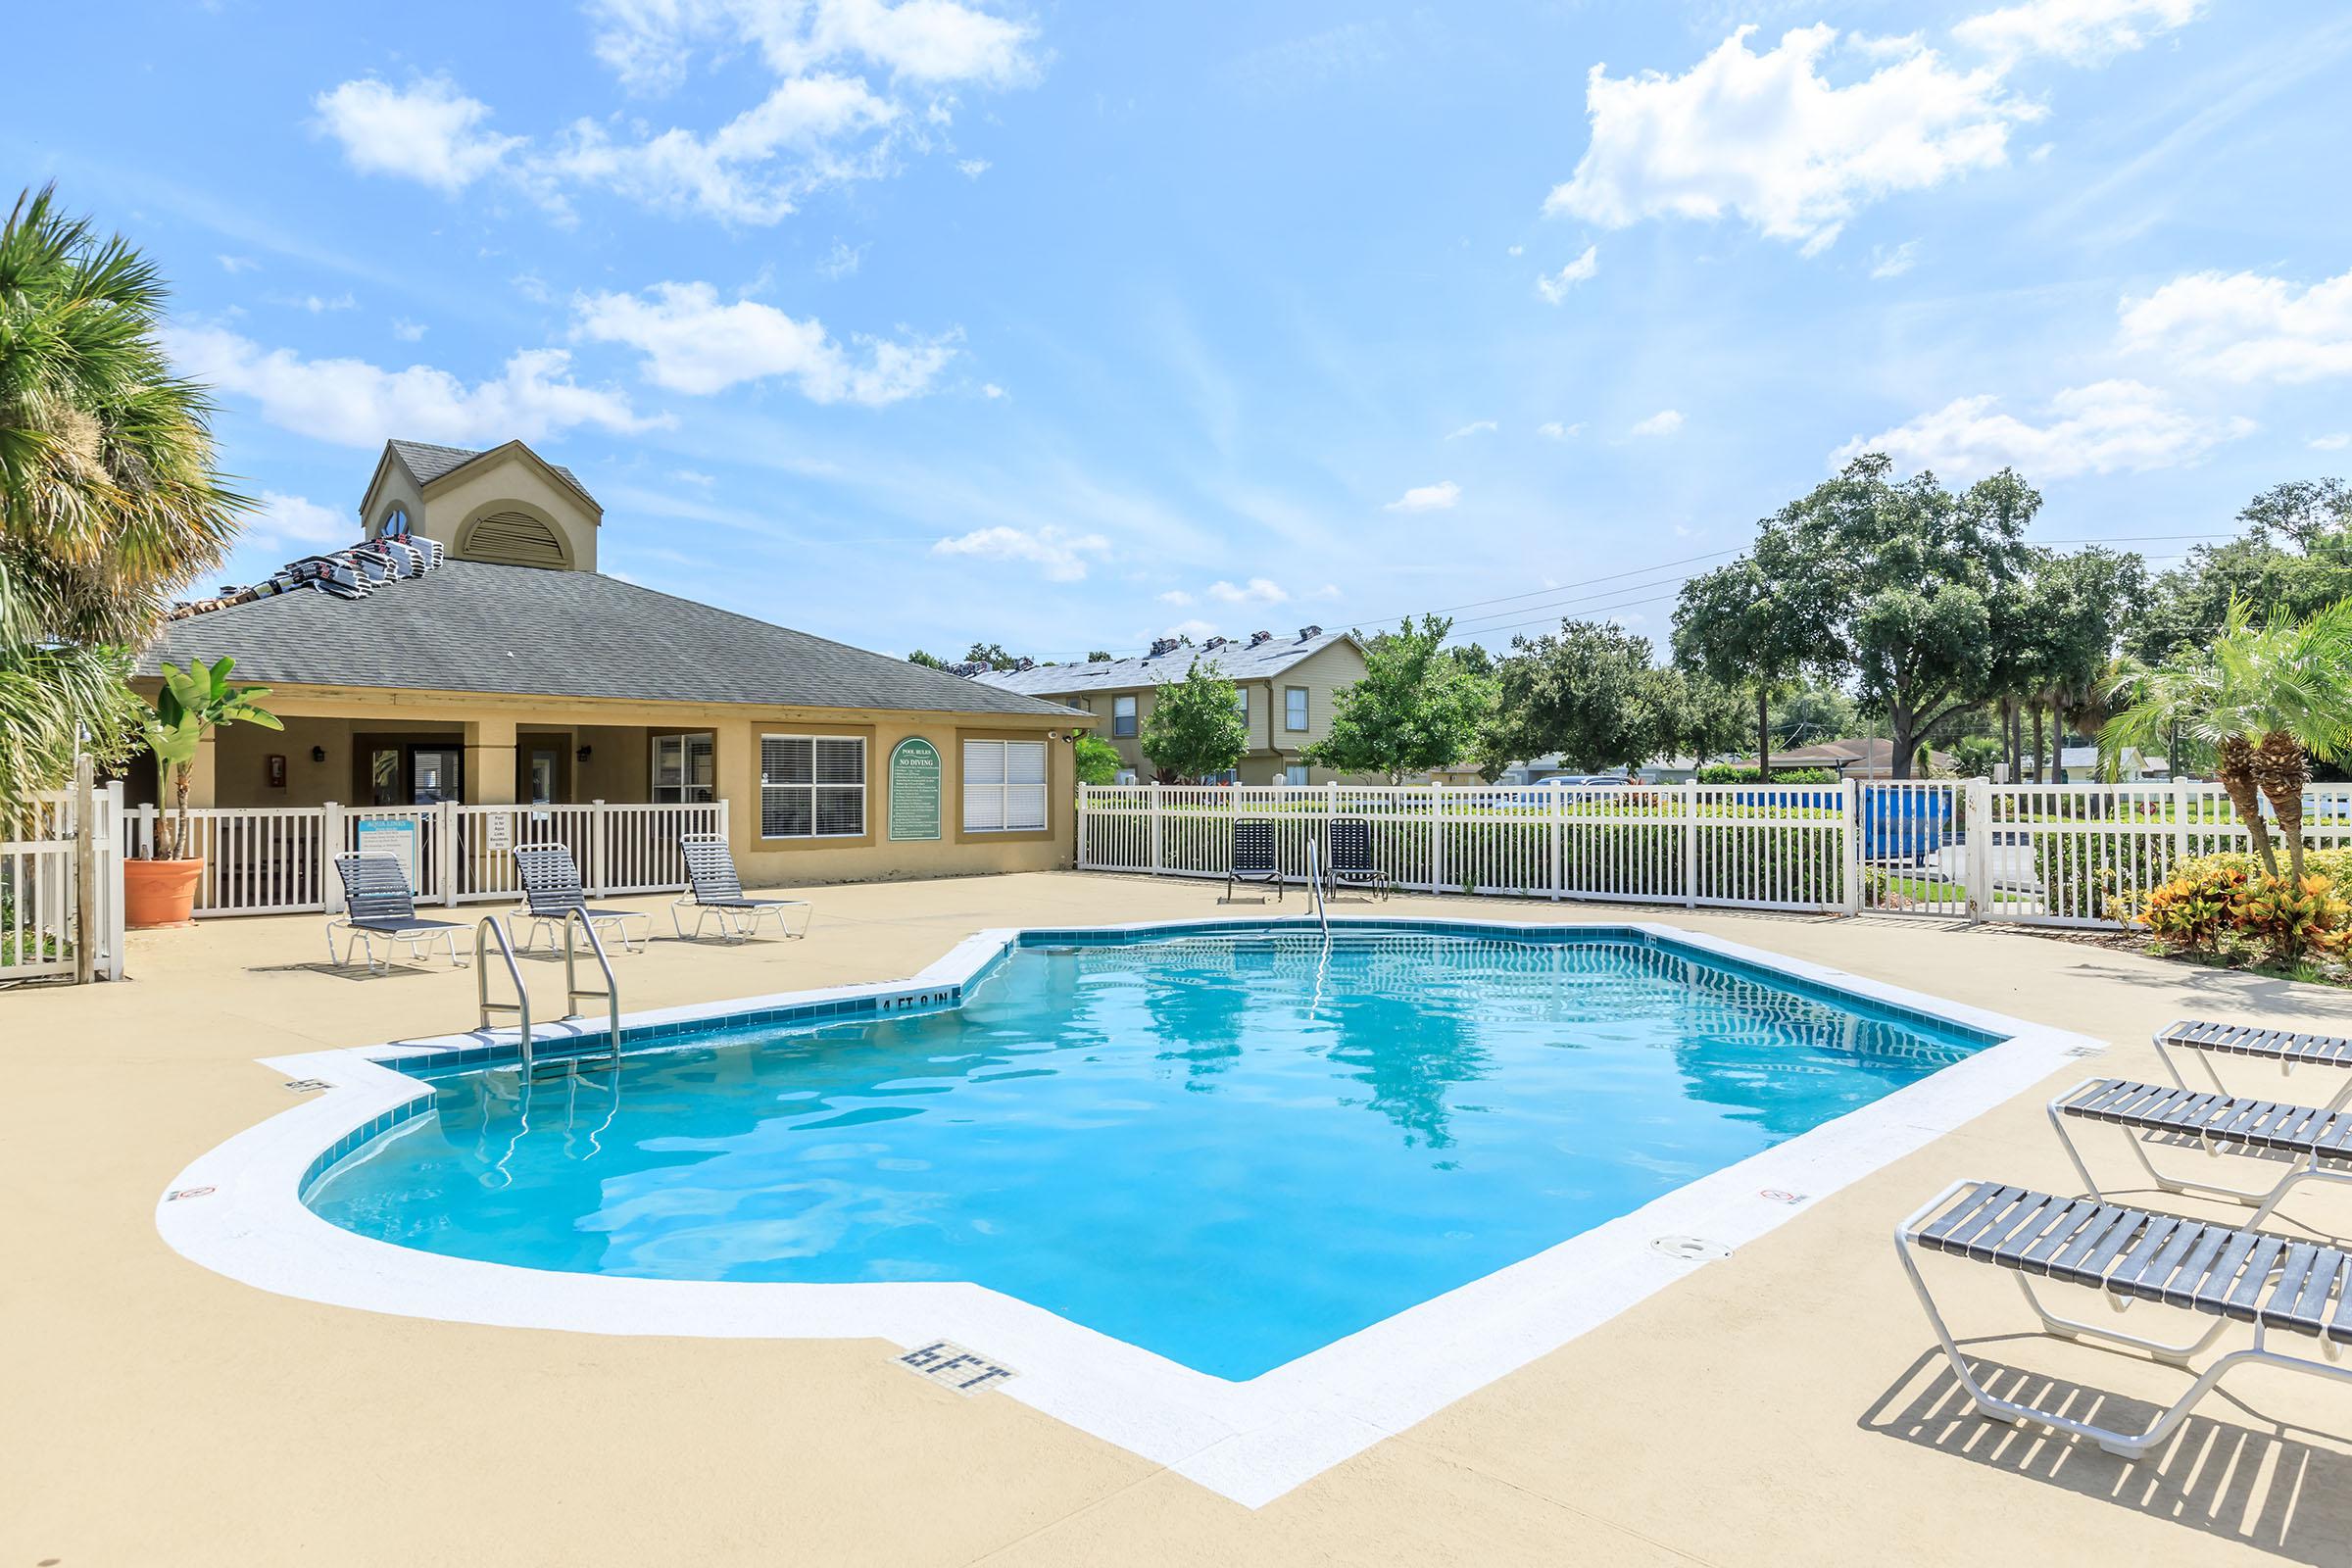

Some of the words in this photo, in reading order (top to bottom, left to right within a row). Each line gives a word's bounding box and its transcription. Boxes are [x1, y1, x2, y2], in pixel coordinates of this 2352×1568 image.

[883, 1000, 891, 1011] 4
[898, 997, 913, 1010] FT
[934, 992, 948, 1004] IN
[901, 1343, 1012, 1390] 6FT
